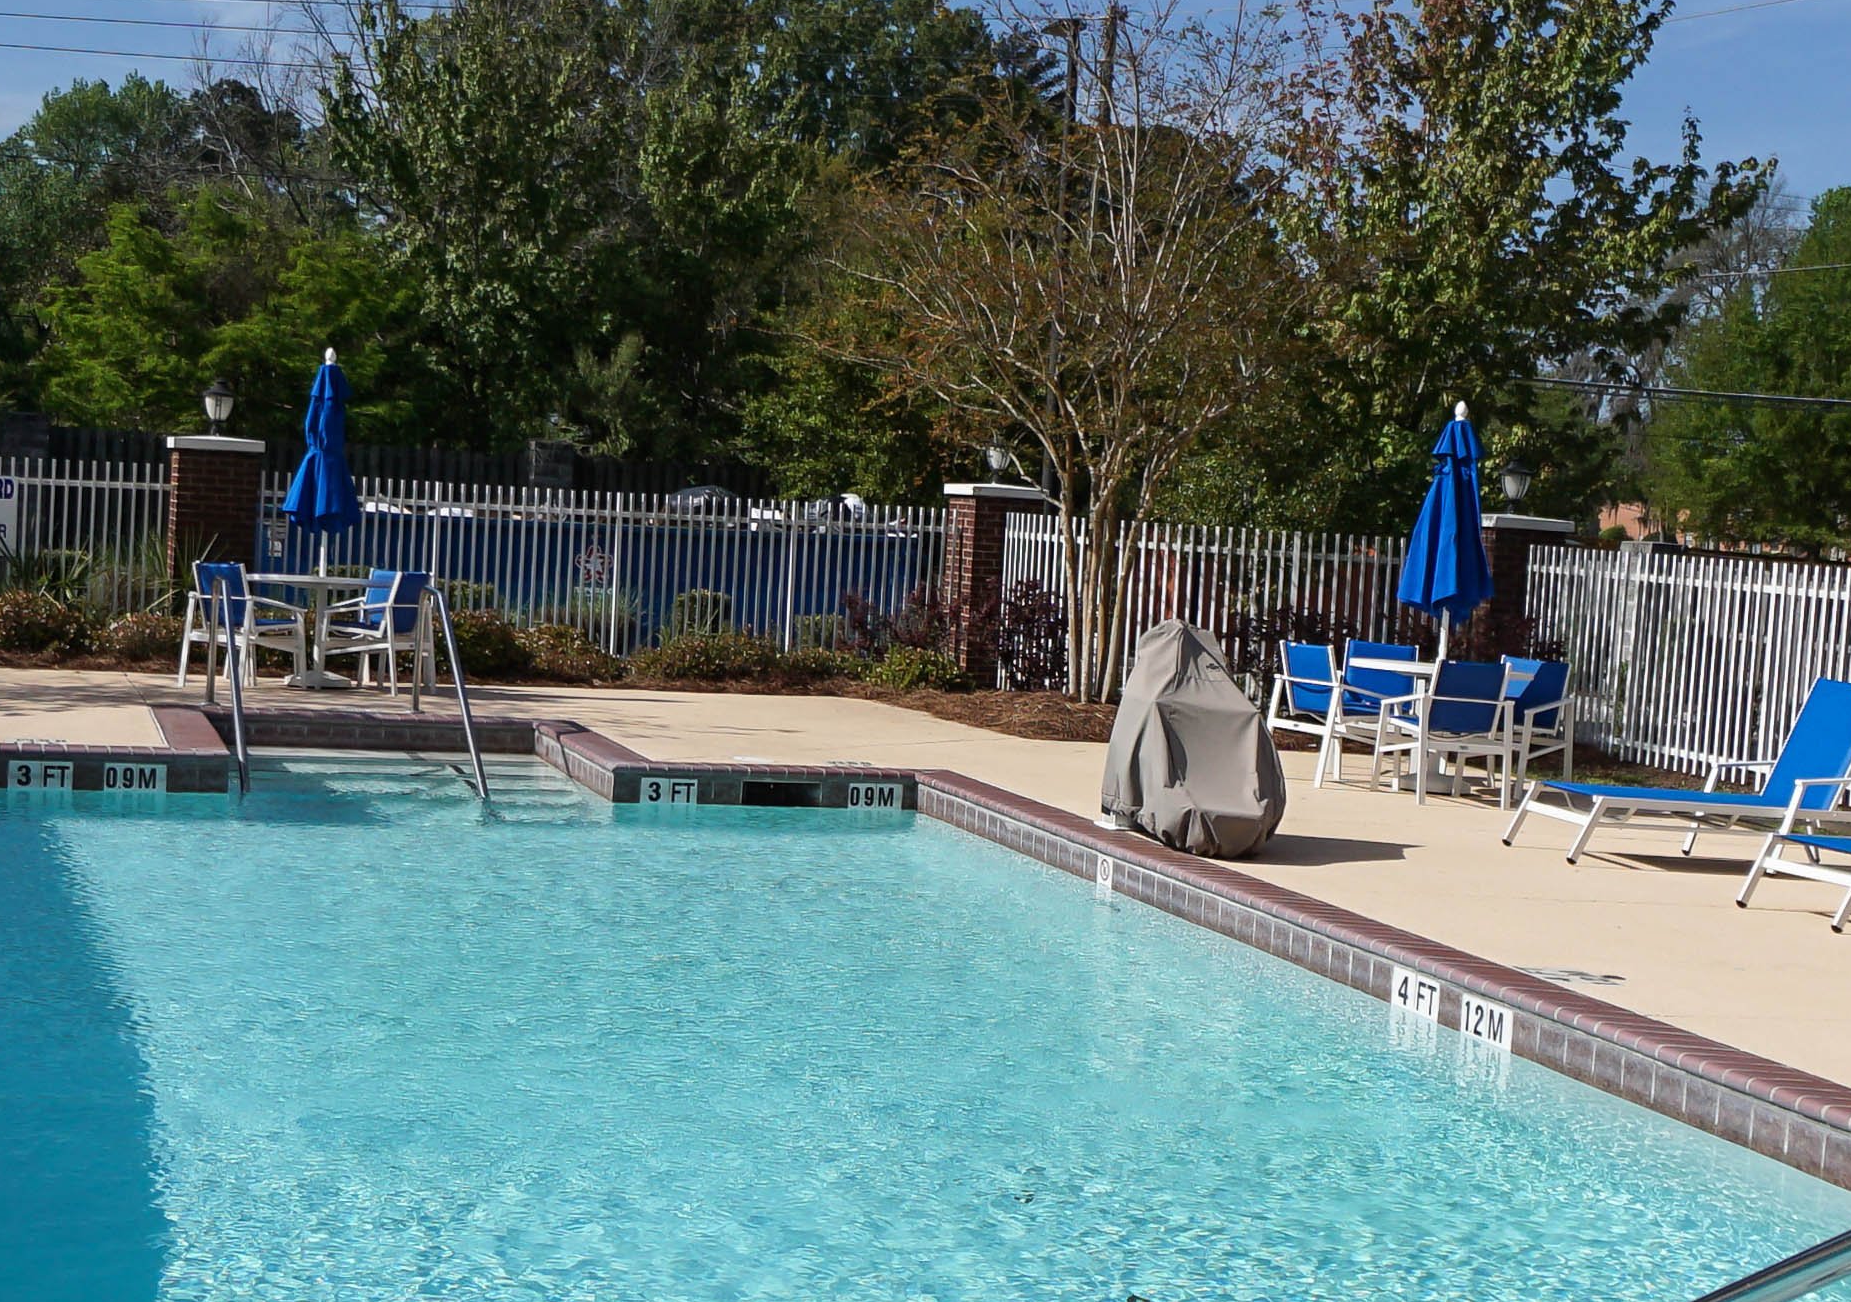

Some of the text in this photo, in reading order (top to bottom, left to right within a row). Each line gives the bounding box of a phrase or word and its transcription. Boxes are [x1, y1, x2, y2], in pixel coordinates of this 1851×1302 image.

[16, 765, 70, 788] 3 FT
[648, 781, 696, 803] 3 FT
[1398, 976, 1437, 1016] 4 FT
